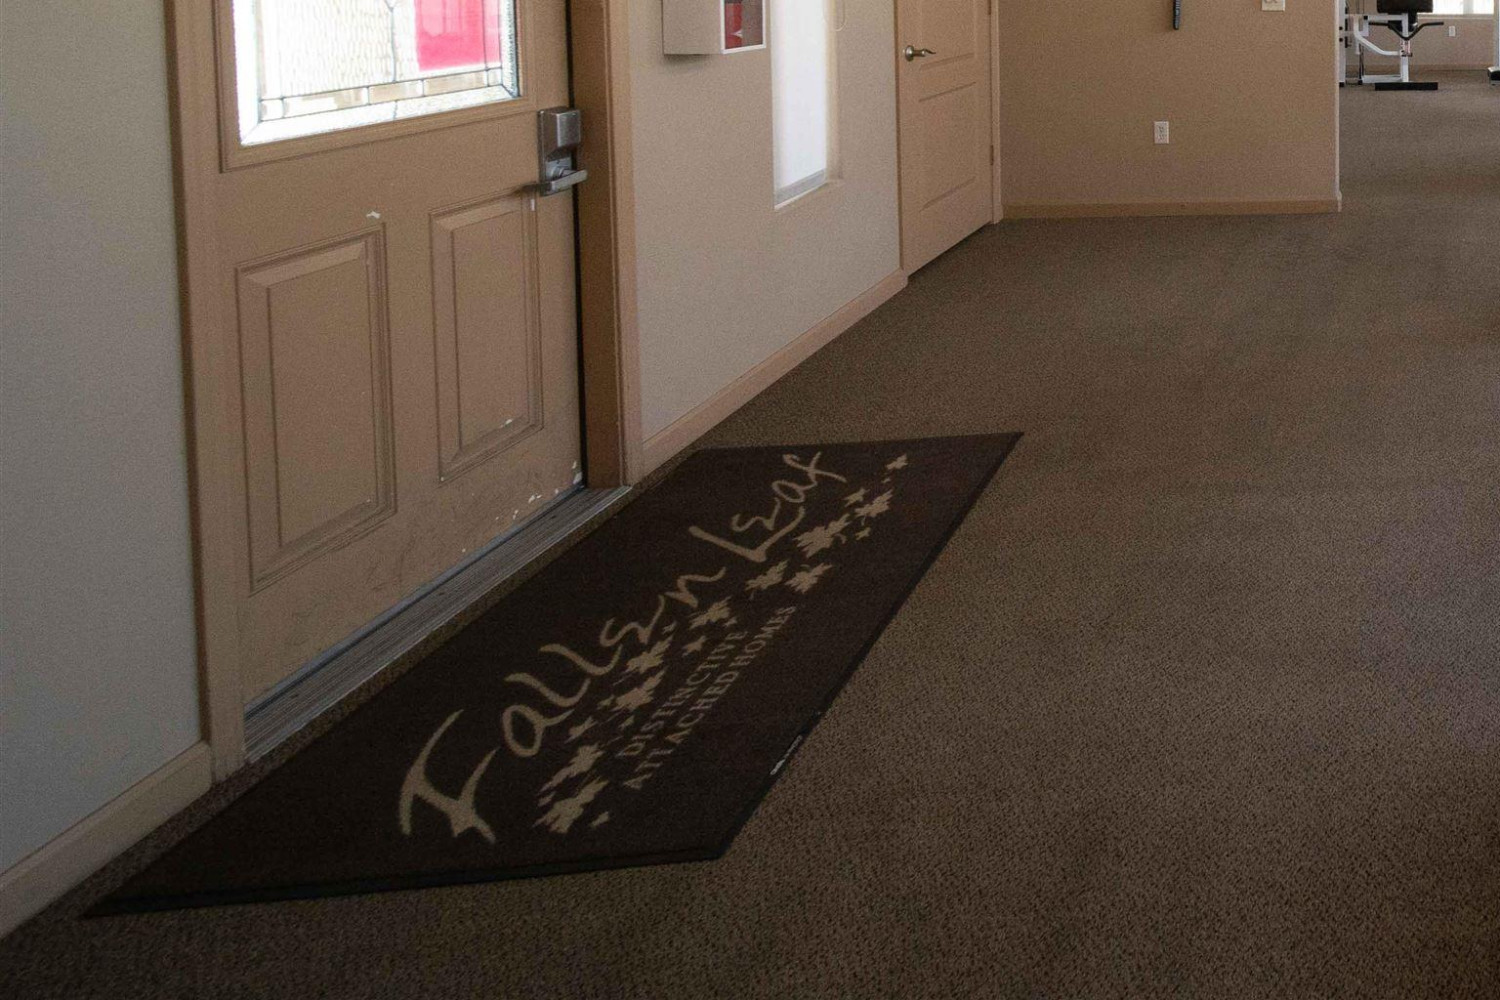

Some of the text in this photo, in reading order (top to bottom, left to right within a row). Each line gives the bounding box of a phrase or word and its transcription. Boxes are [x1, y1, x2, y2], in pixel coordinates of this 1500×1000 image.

[398, 451, 847, 843] Fallen Leaf
[616, 631, 748, 757] DISTINCTIVE
[623, 606, 796, 790] ATTACHED HOMES
